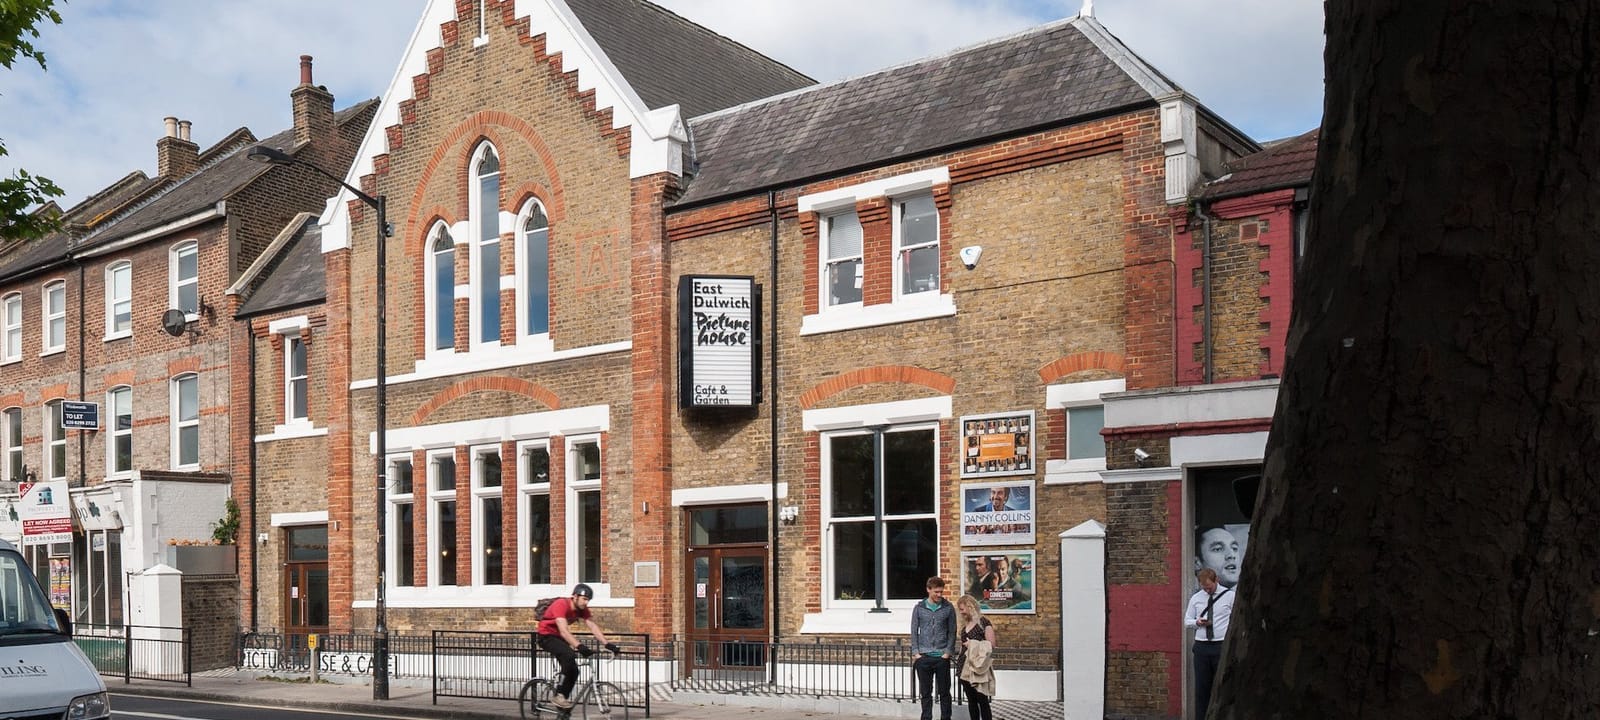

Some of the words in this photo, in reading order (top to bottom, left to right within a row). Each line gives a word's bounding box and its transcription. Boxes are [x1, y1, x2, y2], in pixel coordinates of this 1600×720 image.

[694, 282, 722, 294] East
[694, 296, 750, 309] Dulwich
[694, 312, 750, 331] Picture
[698, 325, 747, 347] house
[720, 385, 728, 395] &
[695, 395, 730, 405] Garden
[964, 514, 994, 523] DANNY
[995, 512, 1031, 522] COLLINS
[240, 650, 336, 672] PICTUREHOSE
[342, 654, 351, 673] &
[357, 654, 392, 675] CAE
